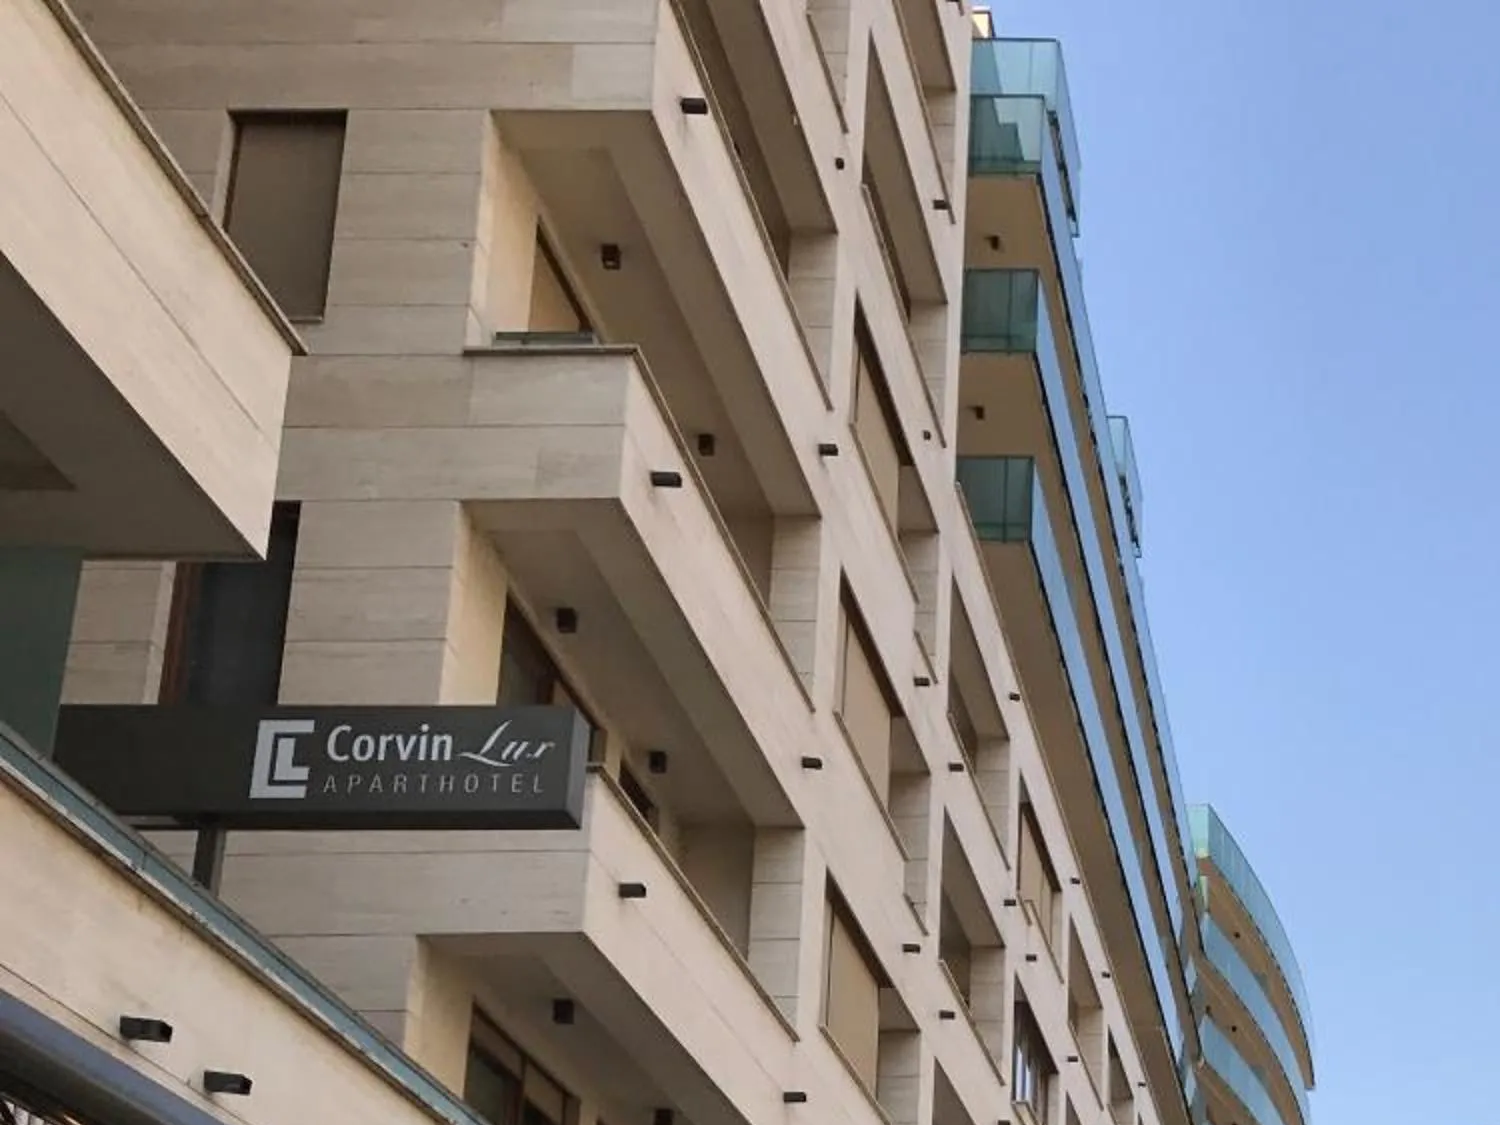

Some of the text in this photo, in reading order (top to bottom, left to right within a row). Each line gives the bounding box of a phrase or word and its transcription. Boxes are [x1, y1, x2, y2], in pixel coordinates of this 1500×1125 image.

[326, 719, 555, 767] Corvin Lux
[322, 773, 545, 794] APARTHOTEL
